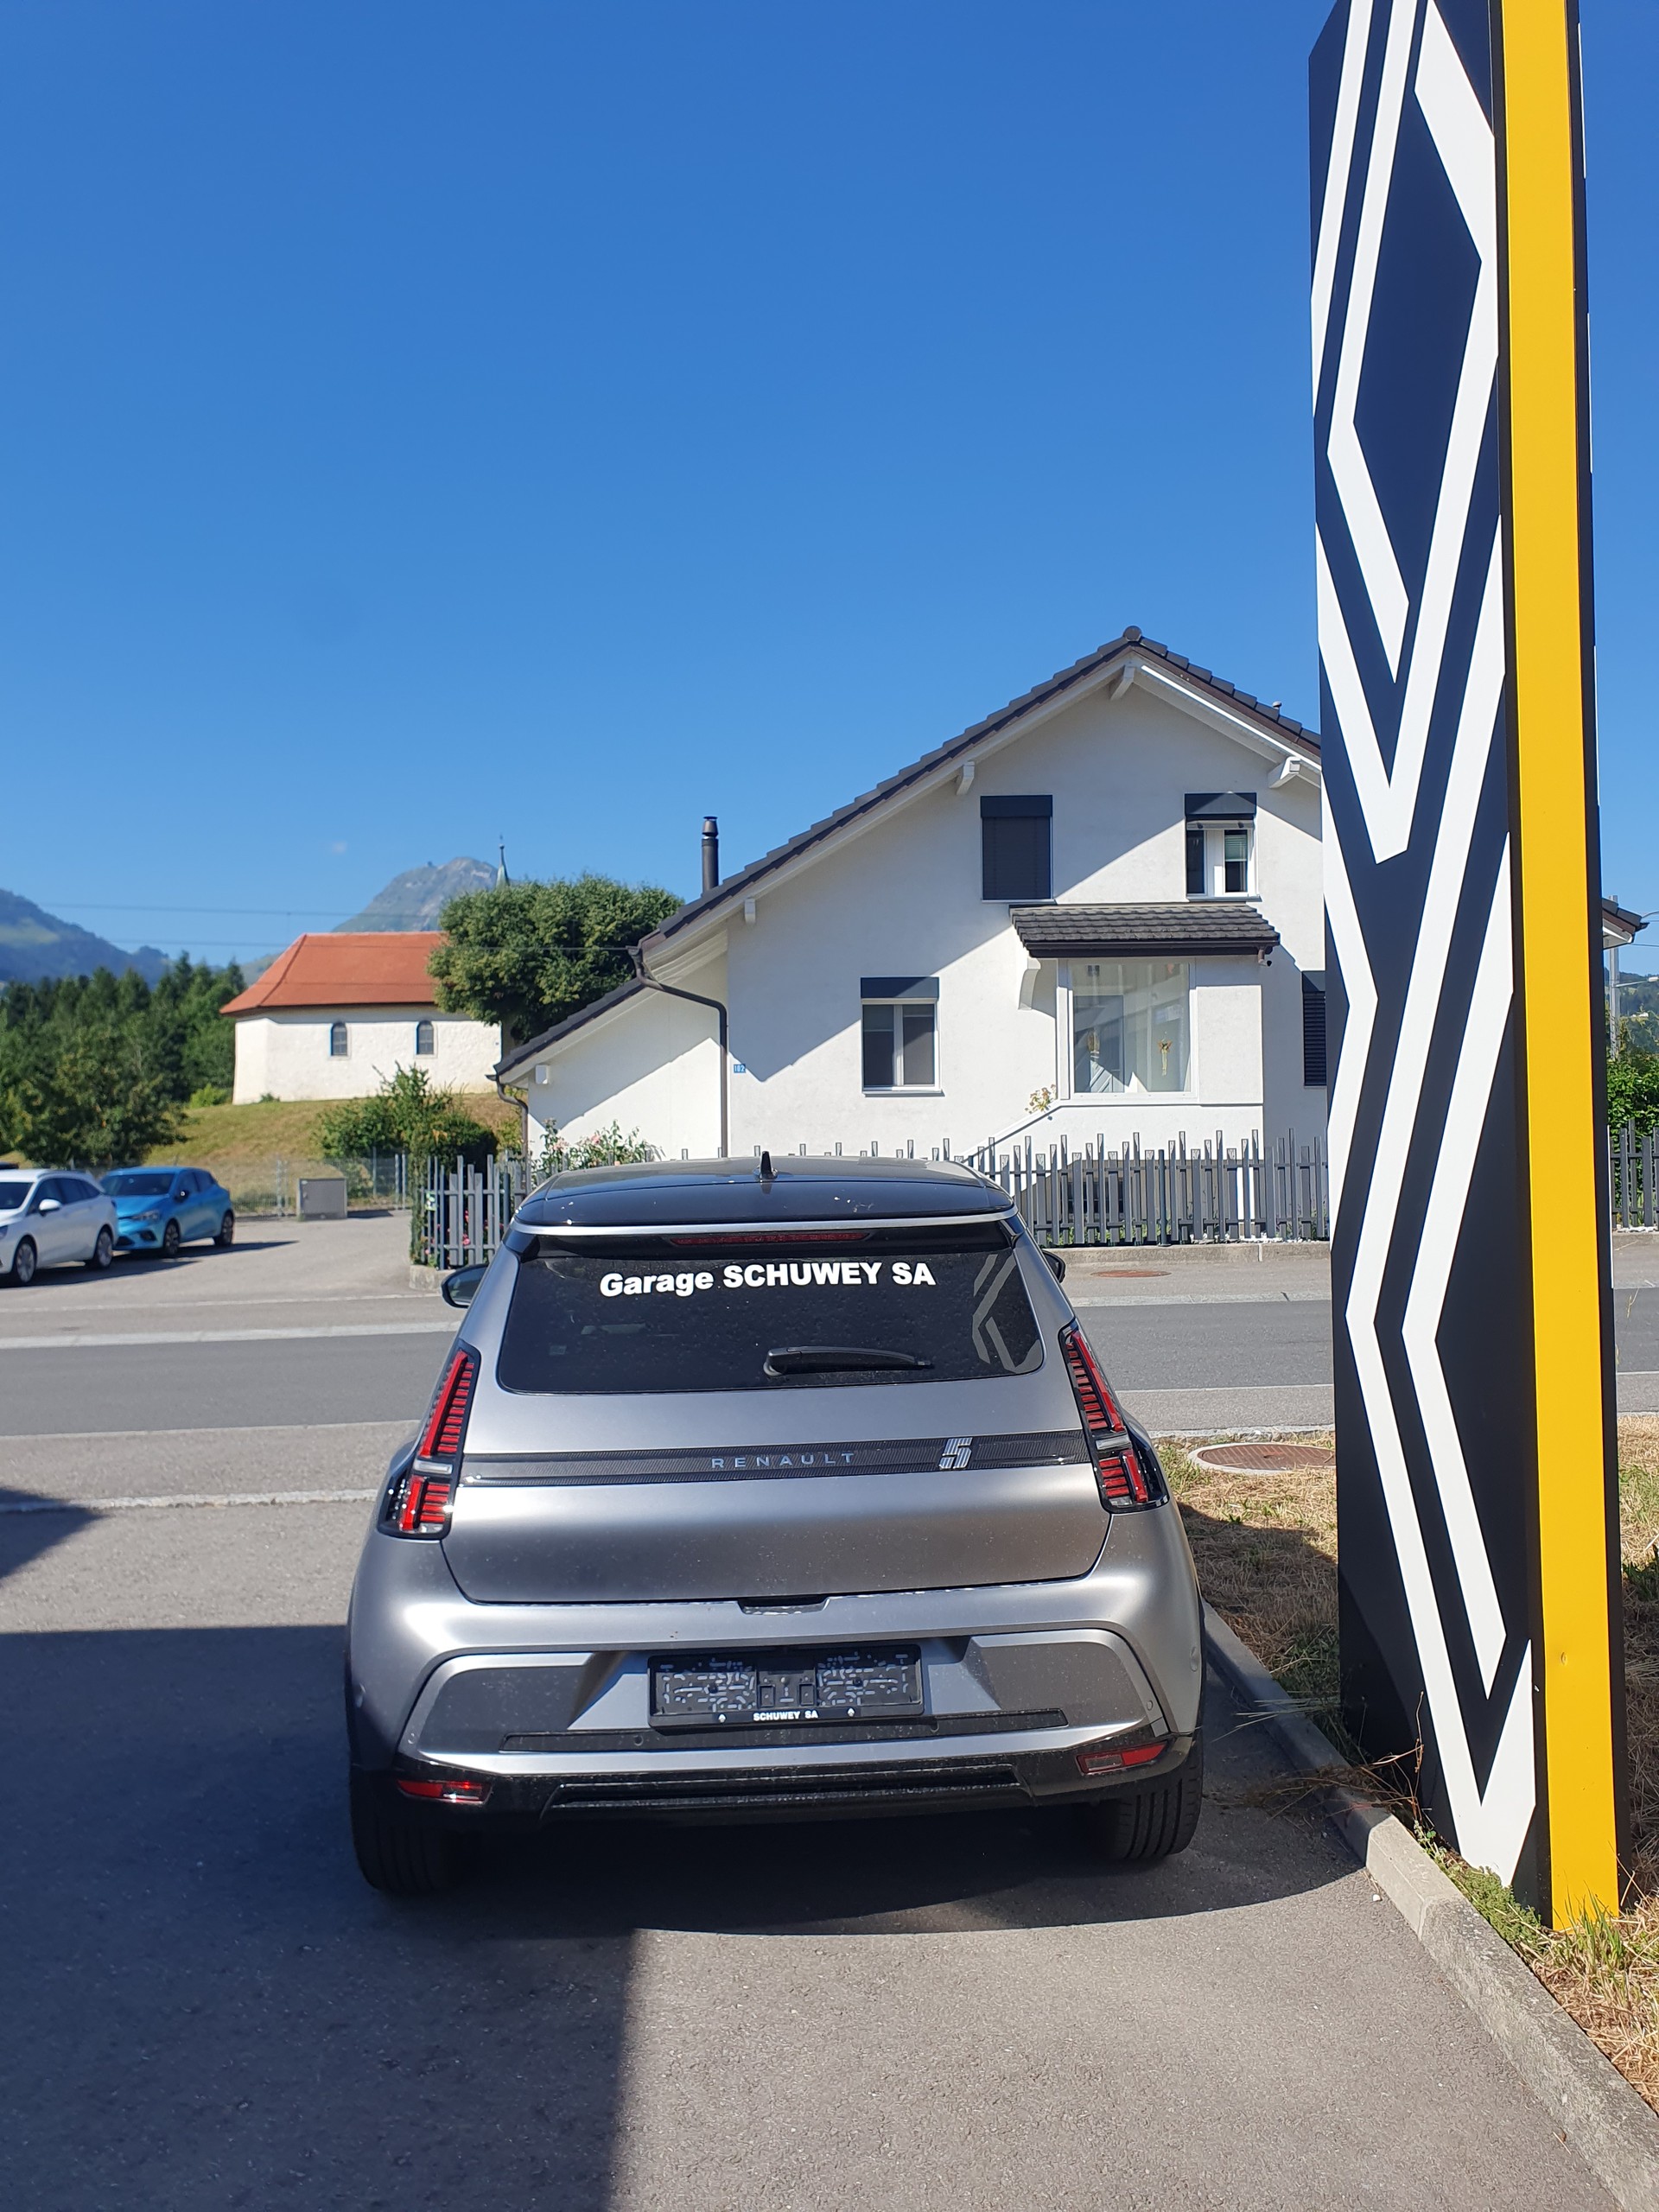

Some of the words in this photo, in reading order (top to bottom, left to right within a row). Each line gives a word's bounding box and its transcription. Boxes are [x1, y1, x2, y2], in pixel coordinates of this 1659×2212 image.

[600, 1271, 714, 1297] Garage
[723, 1262, 882, 1288] SCHUWEY
[892, 1262, 936, 1285] SA
[711, 1452, 855, 1469] RENAULT
[938, 1437, 973, 1469] 5
[753, 1711, 800, 1721] SCHUWEY
[804, 1710, 818, 1719] SA
